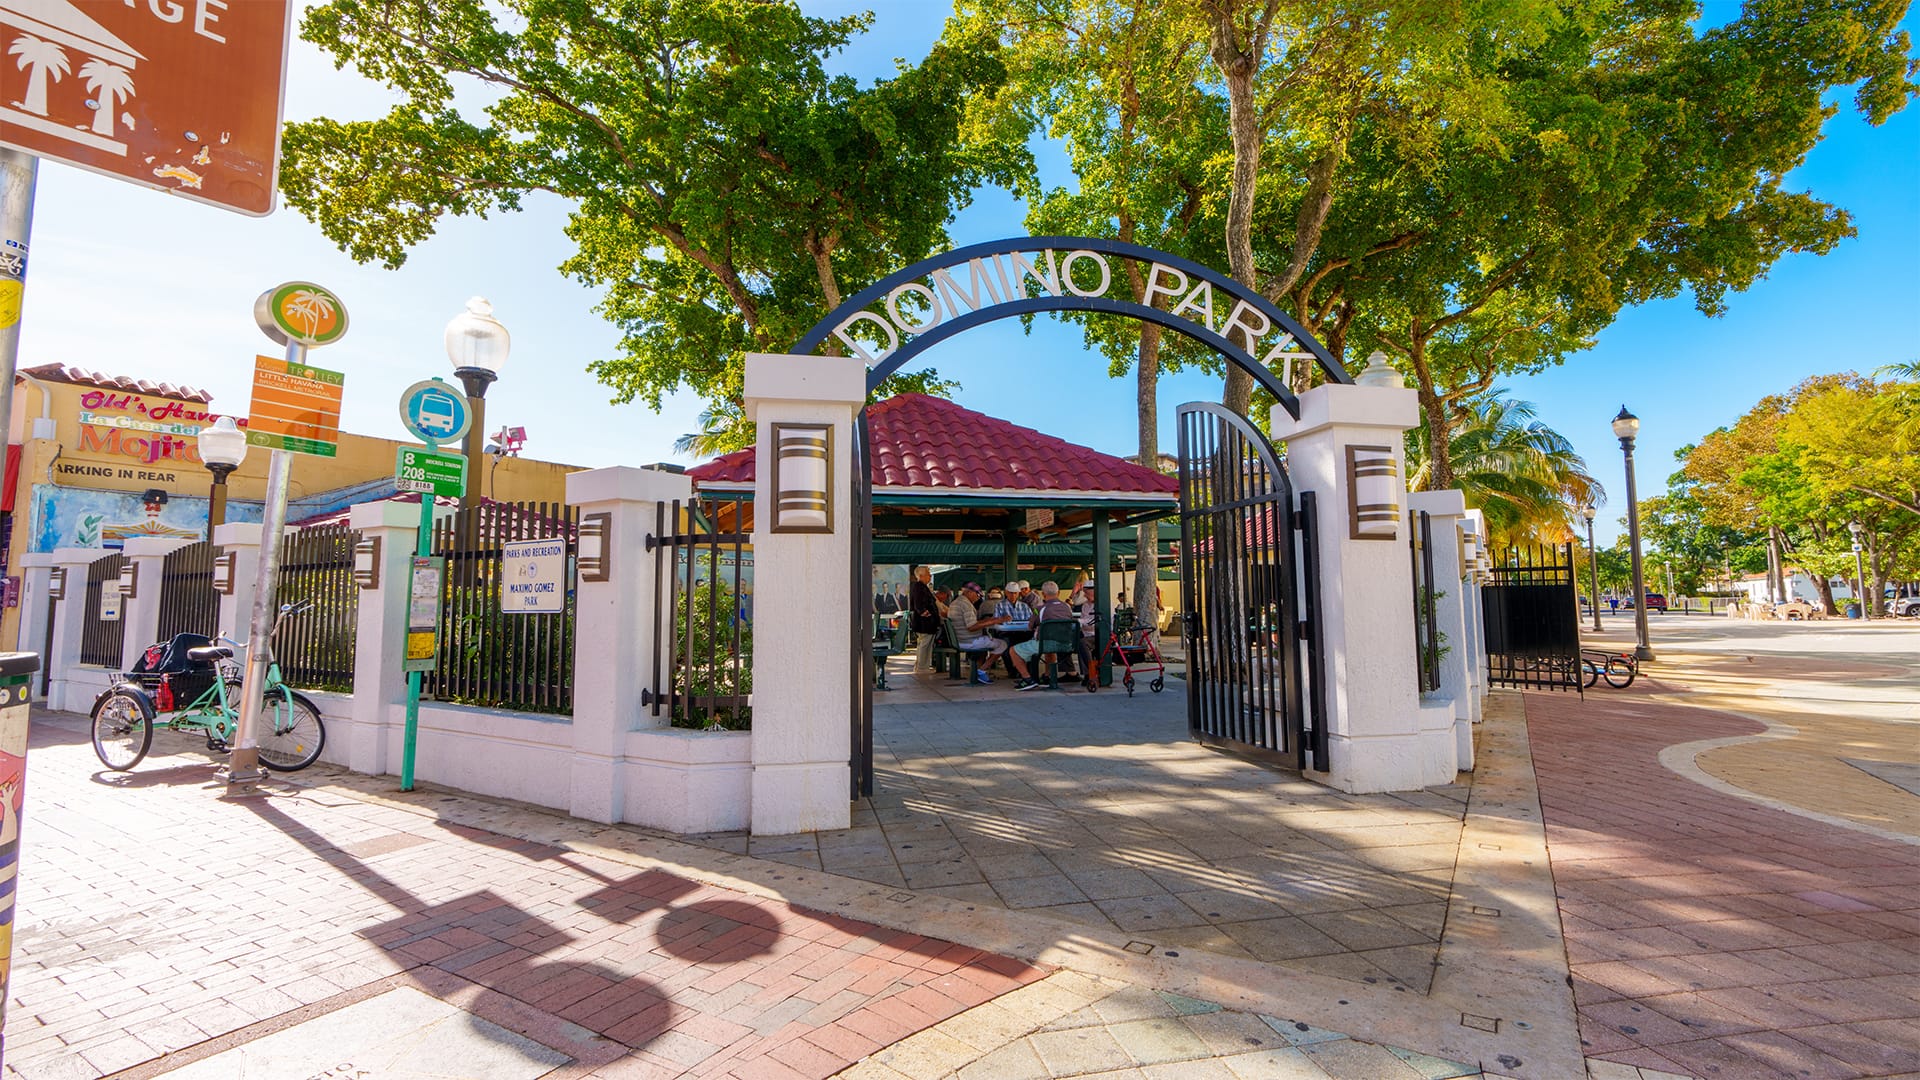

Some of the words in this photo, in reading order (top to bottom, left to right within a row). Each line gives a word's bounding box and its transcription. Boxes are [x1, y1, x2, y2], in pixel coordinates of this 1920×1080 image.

[123, 0, 228, 44] GE
[832, 248, 1111, 368] DOMINO
[1143, 261, 1317, 389] PARK
[260, 372, 288, 383] LITTLE
[291, 379, 325, 390] HAVANA
[289, 366, 340, 384] TROLLEY
[81, 390, 147, 413] Old's
[80, 411, 107, 425] La
[115, 415, 164, 431] Casa
[170, 421, 200, 436] del
[404, 453, 415, 465] 8
[117, 469, 133, 479] IN
[138, 471, 176, 482] REAR
[403, 466, 425, 480] 208
[506, 549, 520, 559] PARKS
[522, 548, 531, 557] AND
[533, 546, 561, 557] RECREATION
[510, 583, 533, 593] MAXIMO
[535, 583, 555, 593] GOMEZ
[524, 596, 538, 606] PARK
